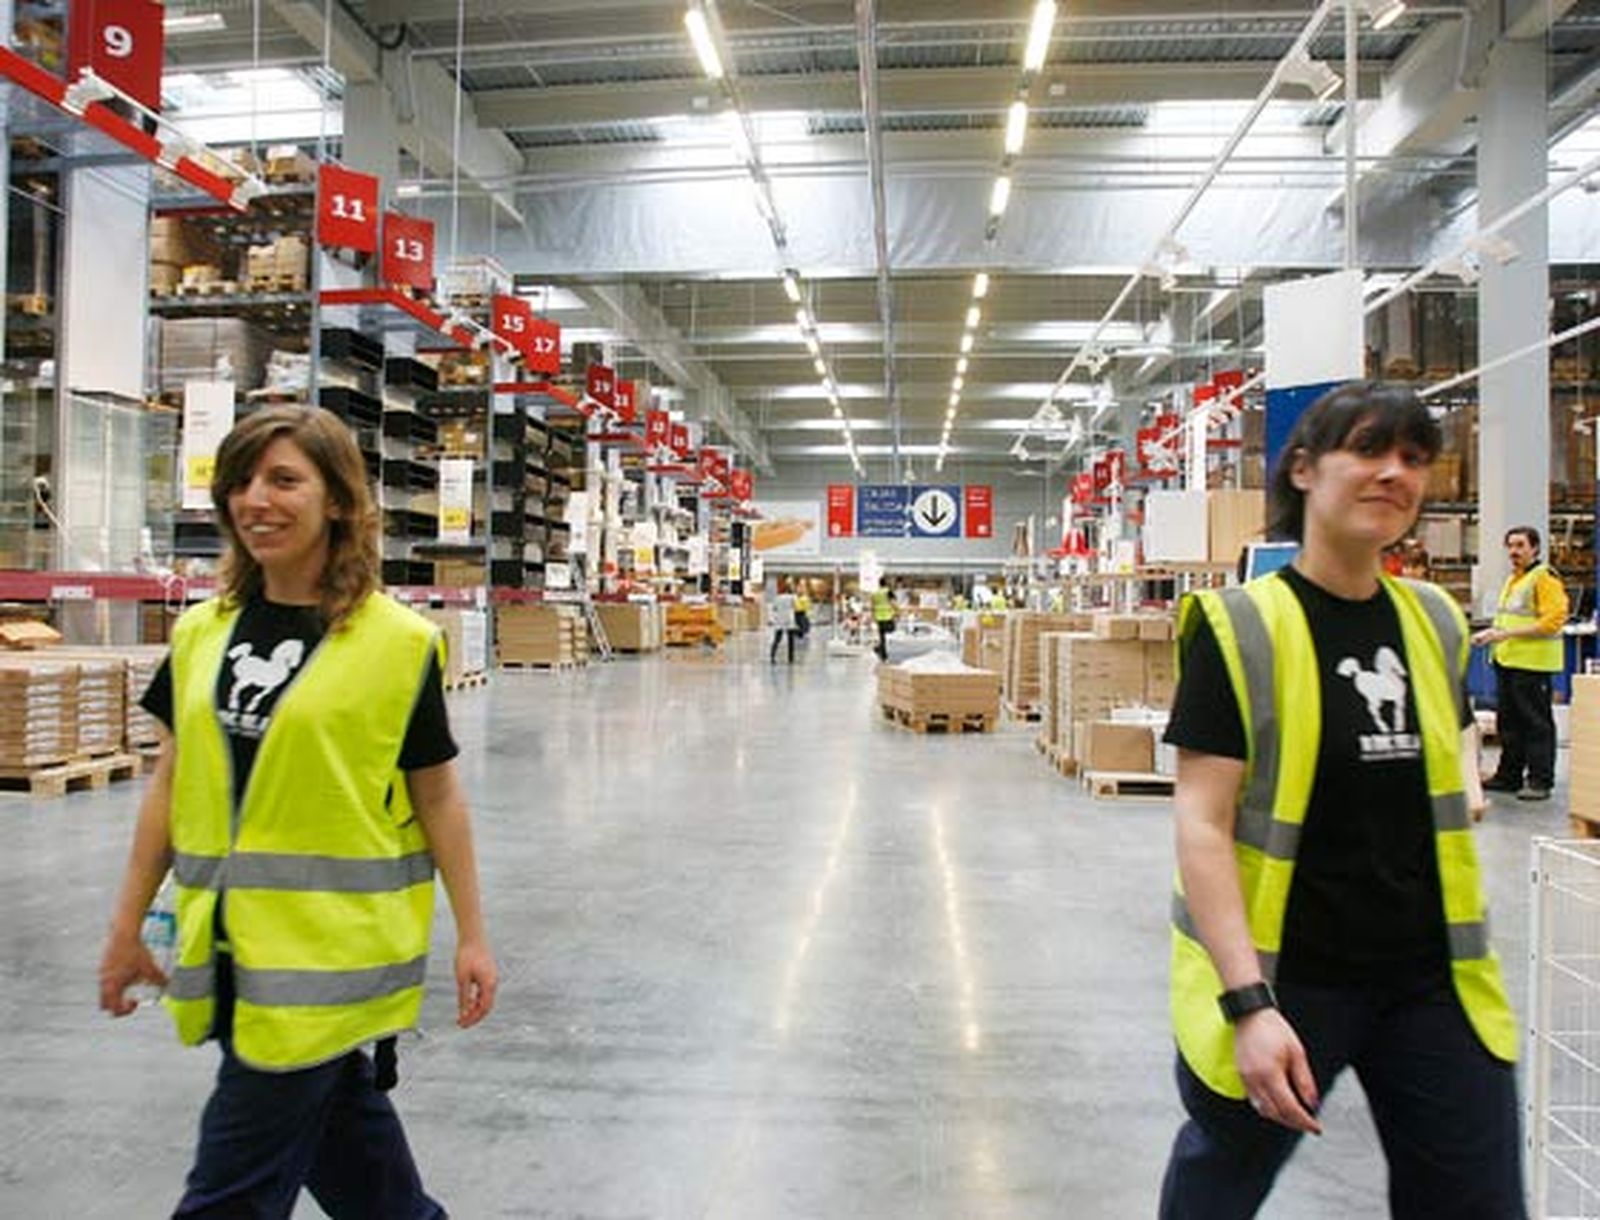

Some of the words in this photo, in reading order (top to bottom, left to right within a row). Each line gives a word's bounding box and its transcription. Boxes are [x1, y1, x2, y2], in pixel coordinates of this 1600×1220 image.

[104, 26, 133, 57] 9
[331, 195, 366, 221] 11
[395, 239, 424, 261] 13
[502, 314, 524, 332] 15
[534, 337, 555, 353] 17
